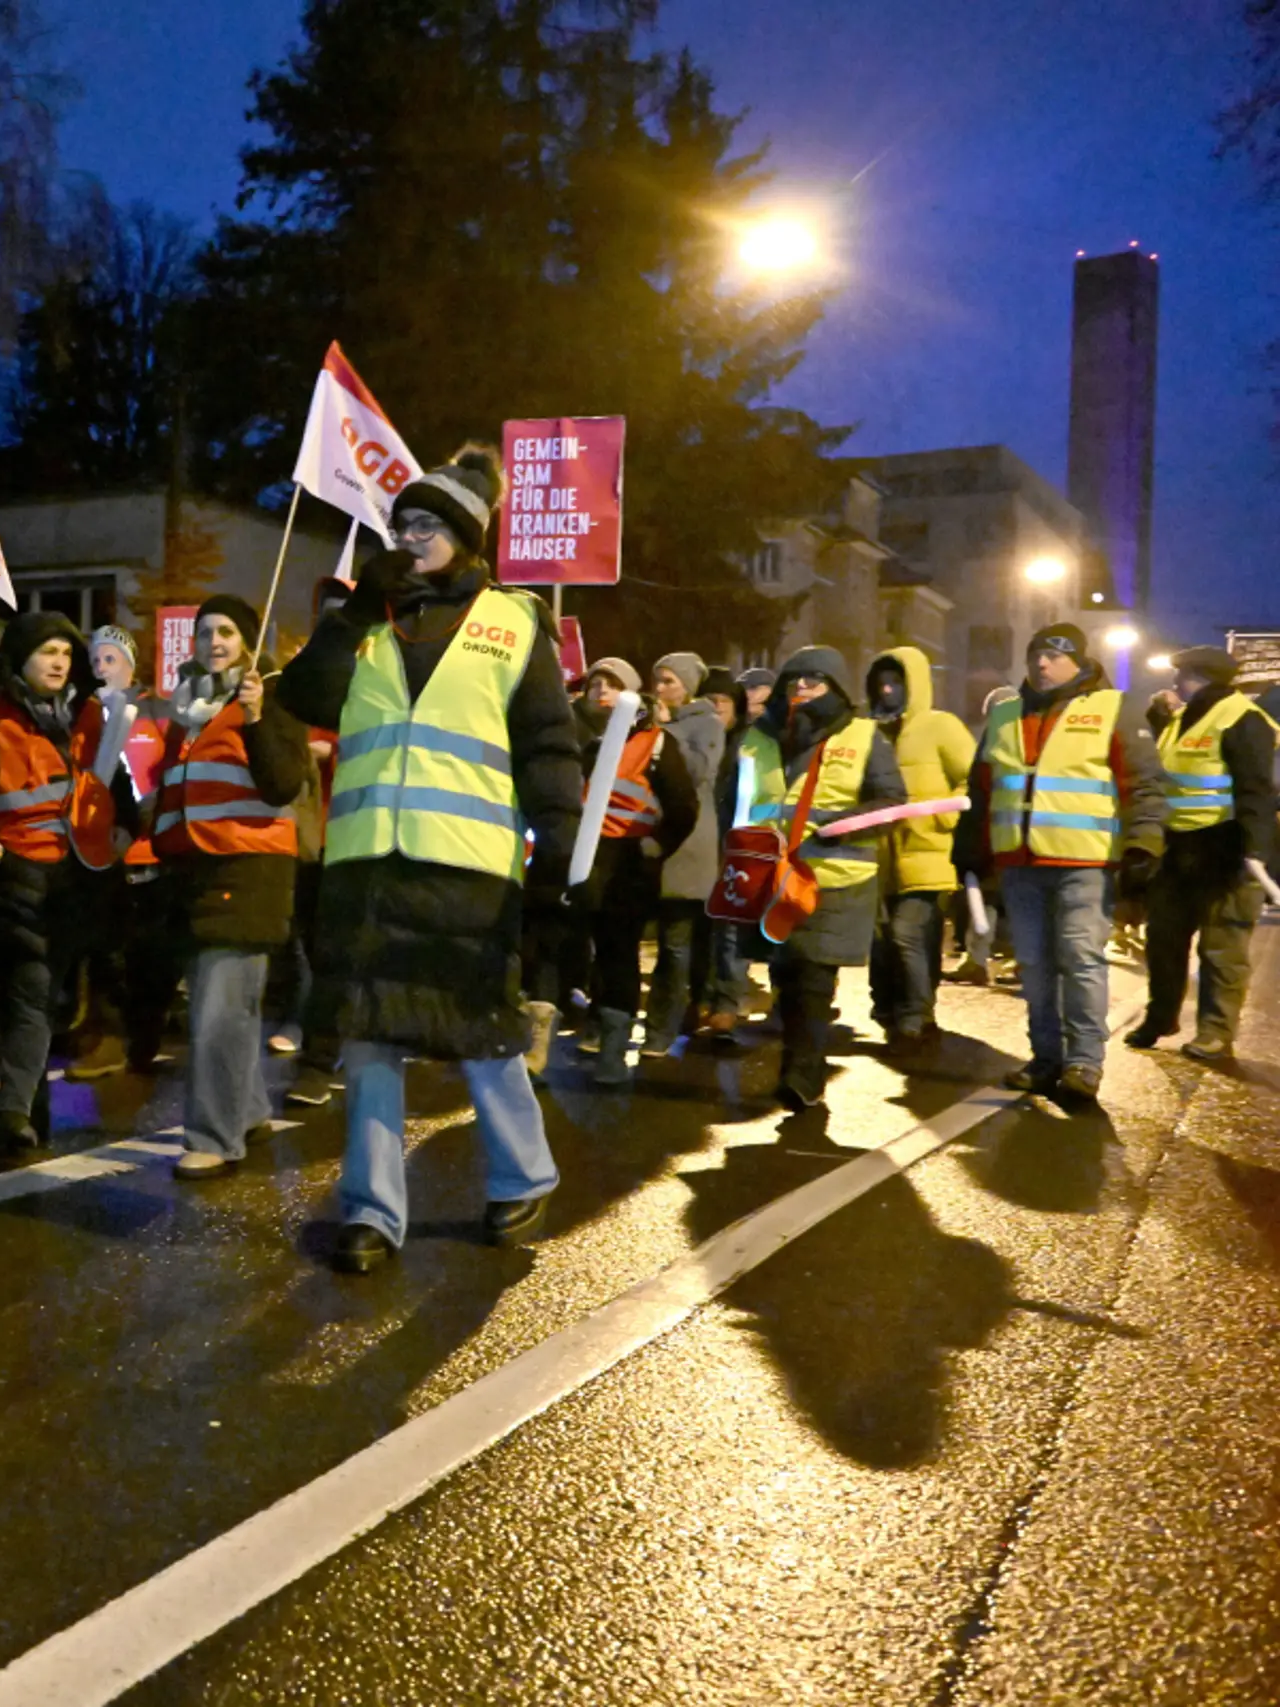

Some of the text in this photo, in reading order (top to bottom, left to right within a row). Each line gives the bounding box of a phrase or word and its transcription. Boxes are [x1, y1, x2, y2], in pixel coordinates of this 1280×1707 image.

[513, 436, 588, 461] GEMEIN-
[512, 463, 551, 486] SAM
[511, 484, 577, 511] FÜR DIE
[510, 512, 598, 535] KRANKEN-
[509, 534, 577, 560] HÄUSER
